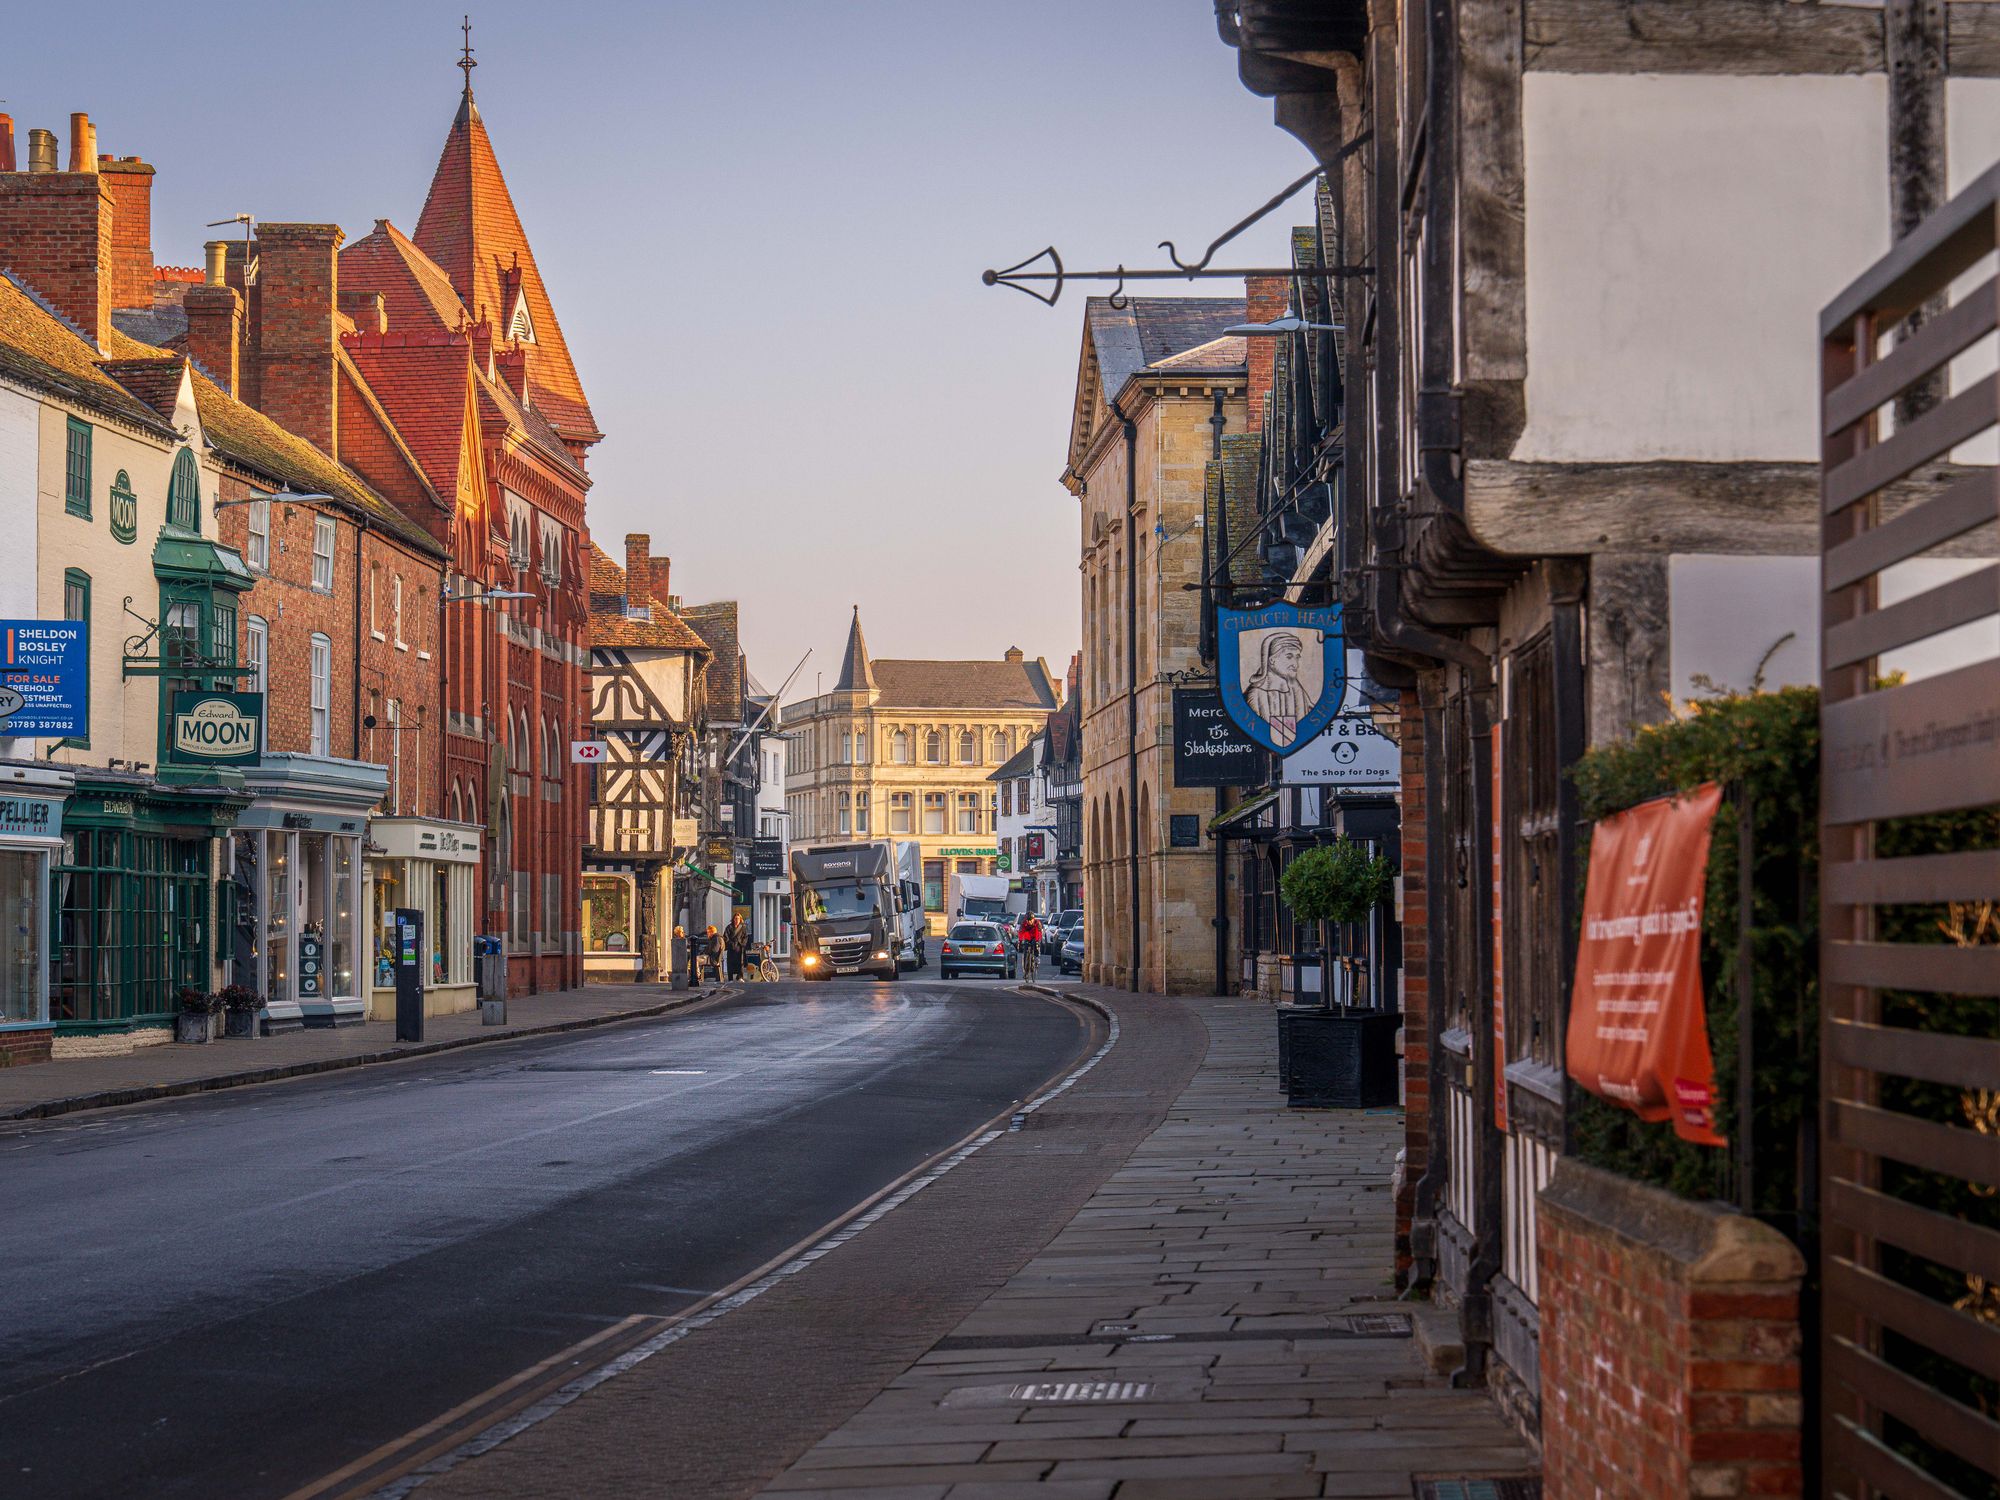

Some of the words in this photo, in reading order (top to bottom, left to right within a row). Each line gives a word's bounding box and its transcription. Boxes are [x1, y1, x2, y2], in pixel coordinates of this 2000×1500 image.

[112, 495, 136, 529] MOON
[1224, 611, 1289, 630] CHAUCER
[1297, 610, 1338, 627] HEAD
[18, 629, 77, 639] SHELDON
[18, 642, 67, 652] BOSLEY
[18, 655, 64, 664] KNIGHT
[7, 675, 30, 683] FOR
[33, 675, 61, 684] SALE
[199, 709, 234, 719] Edward
[1188, 708, 1224, 718] Merc
[7, 721, 36, 729] 01789
[38, 721, 73, 729] 387882
[1338, 724, 1350, 736] &
[1355, 724, 1378, 736] Ba
[182, 720, 251, 745] MOON
[1207, 724, 1229, 740] The
[1184, 740, 1253, 757] Shakespeare
[1301, 769, 1319, 777] The
[1321, 769, 1345, 779] Shop
[1348, 768, 1364, 777] for
[1365, 768, 1390, 779] Dogs
[940, 848, 974, 856] LLOYDS
